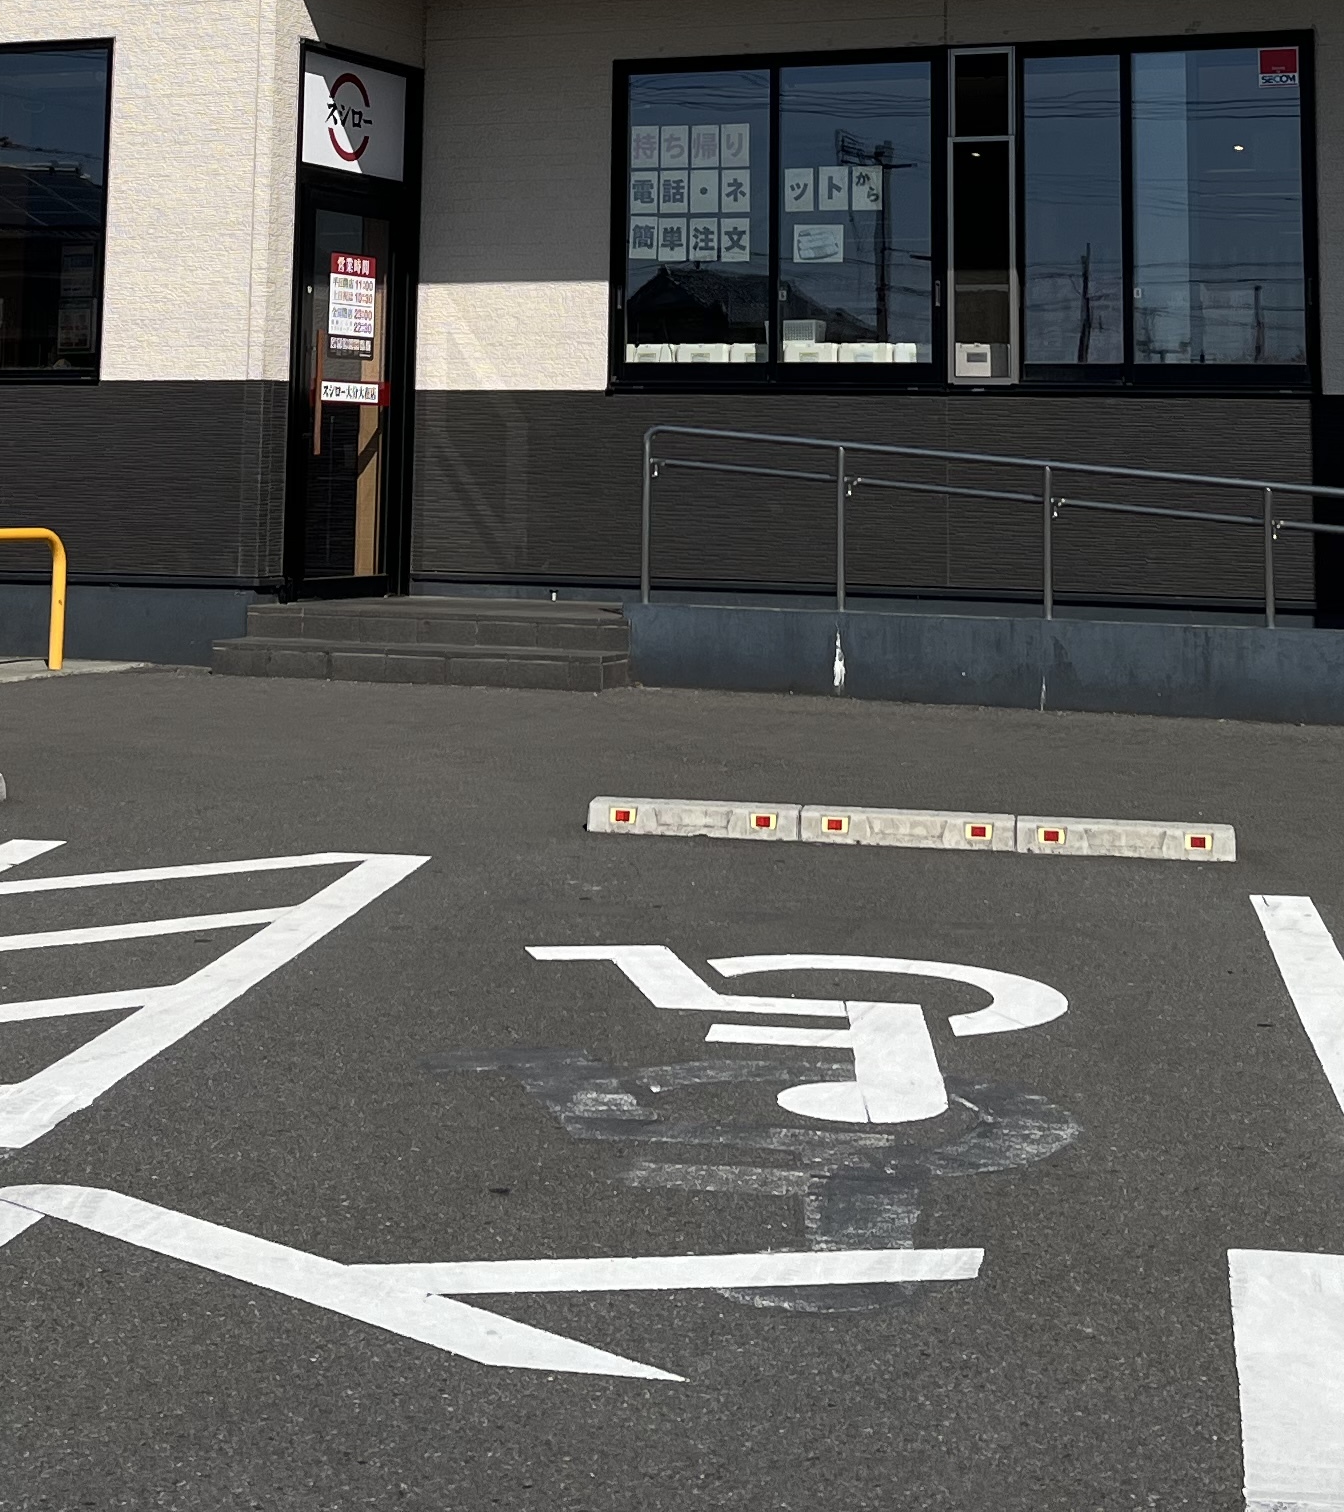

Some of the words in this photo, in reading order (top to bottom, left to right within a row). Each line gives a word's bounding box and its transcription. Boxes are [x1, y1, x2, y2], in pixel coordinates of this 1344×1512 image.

[1261, 74, 1296, 84] SECOM
[325, 102, 373, 128] スシロー
[632, 132, 744, 160] 持ち帰り
[632, 223, 747, 252] 簡単注文
[337, 256, 370, 276] 営業時間
